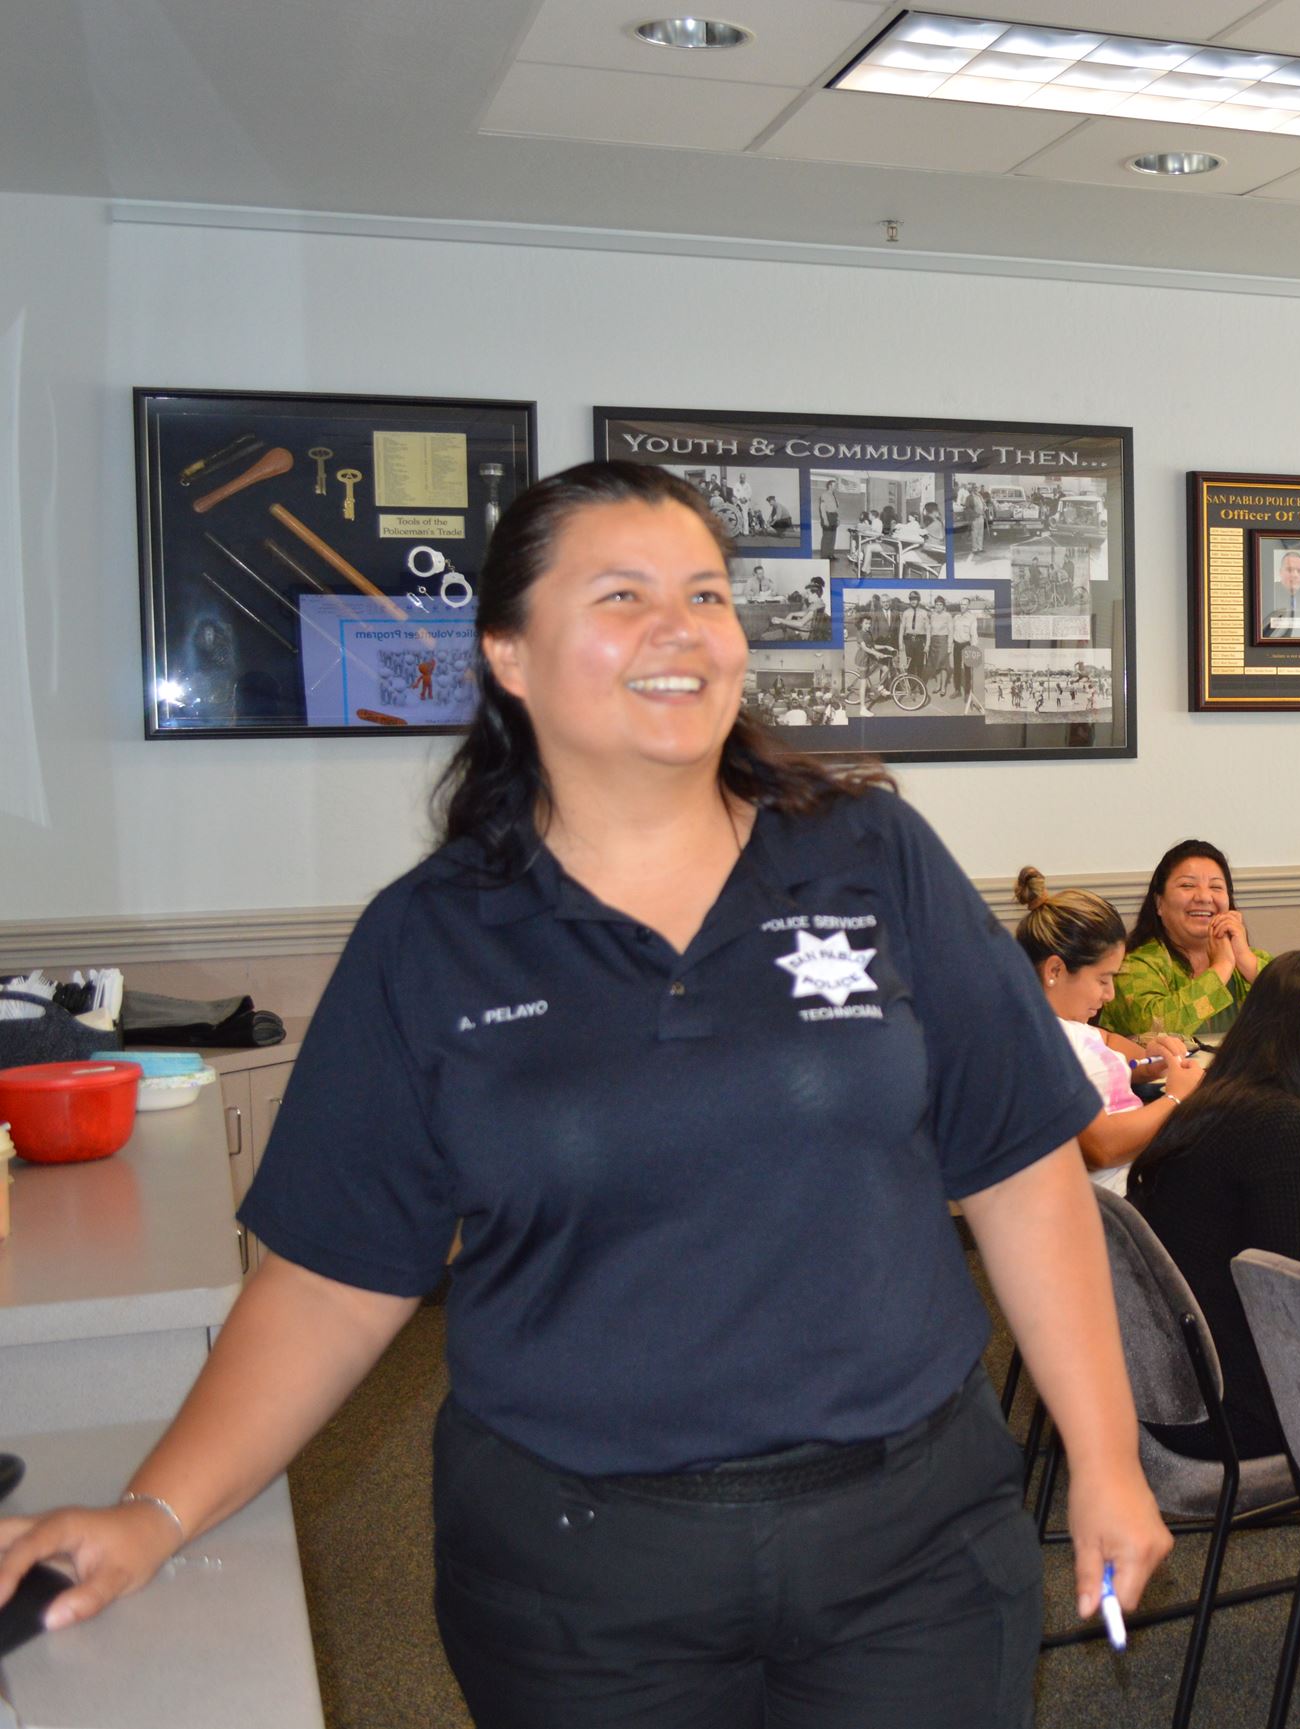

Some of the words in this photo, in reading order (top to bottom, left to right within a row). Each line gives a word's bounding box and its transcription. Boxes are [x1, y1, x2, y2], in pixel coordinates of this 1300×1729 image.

[750, 437, 775, 456] &
[1207, 495, 1227, 505] SAN
[1229, 496, 1264, 506] PABLO
[397, 517, 420, 526] Tools
[422, 518, 432, 526] of
[434, 518, 448, 526] the
[1220, 509, 1271, 521] Officer
[1275, 511, 1294, 522] Of
[383, 527, 435, 536] Policeman's
[437, 528, 462, 536] Trade
[761, 915, 810, 932] POLICE
[813, 914, 877, 930] SERVICES
[802, 973, 860, 989] POLICE
[484, 1000, 549, 1024] PELAYO
[799, 1005, 883, 1021] TECHNICIAN
